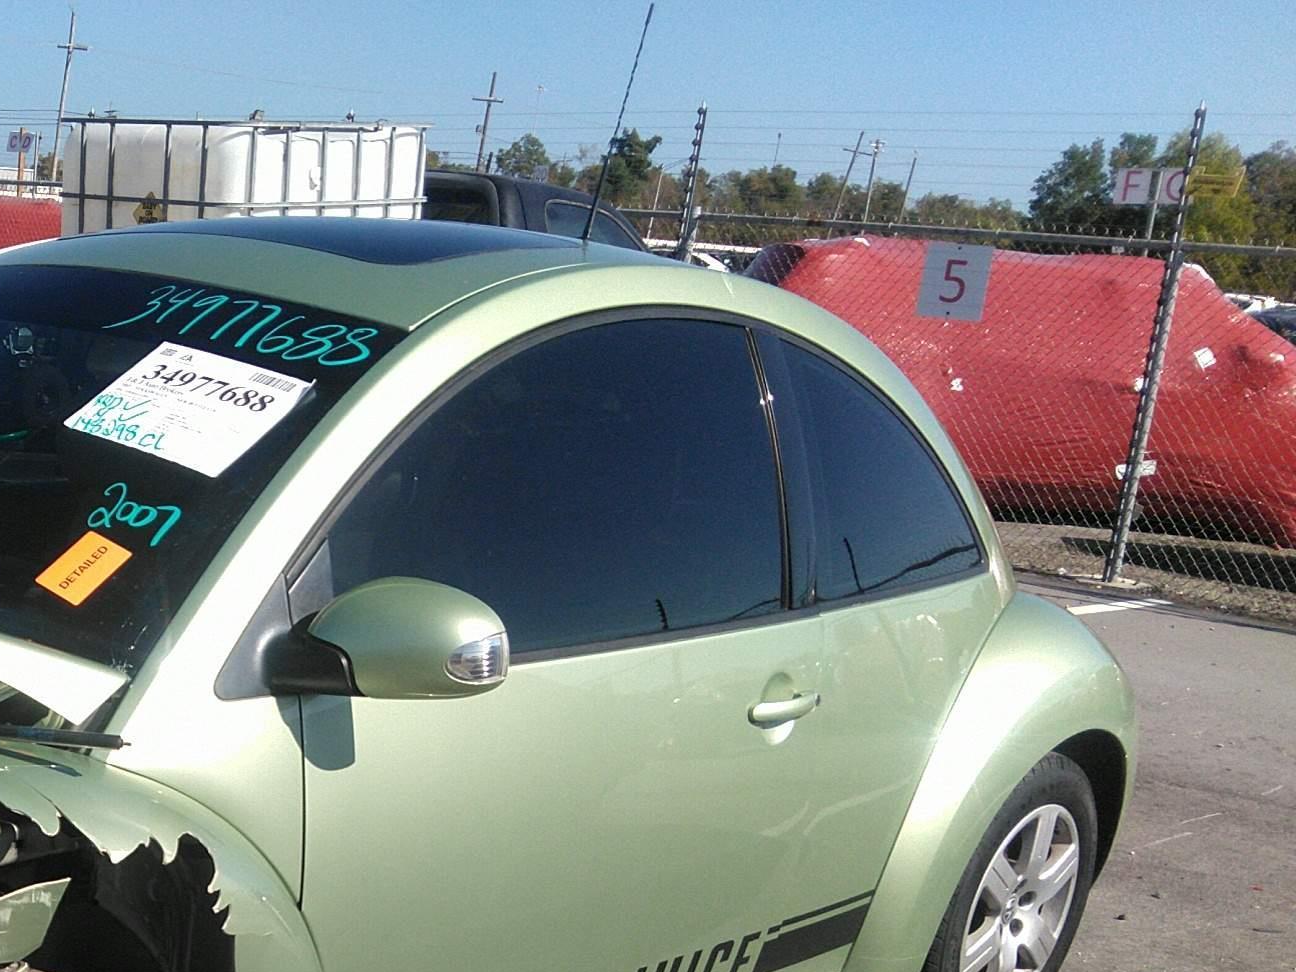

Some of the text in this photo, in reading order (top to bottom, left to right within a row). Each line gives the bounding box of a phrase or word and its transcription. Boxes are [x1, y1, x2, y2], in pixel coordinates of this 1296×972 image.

[1122, 170, 1142, 201] F
[939, 259, 968, 303] 5
[101, 285, 379, 366] 34977688
[142, 364, 275, 412] 34977688
[87, 482, 182, 547] 2007
[58, 545, 109, 590] DETAILED
